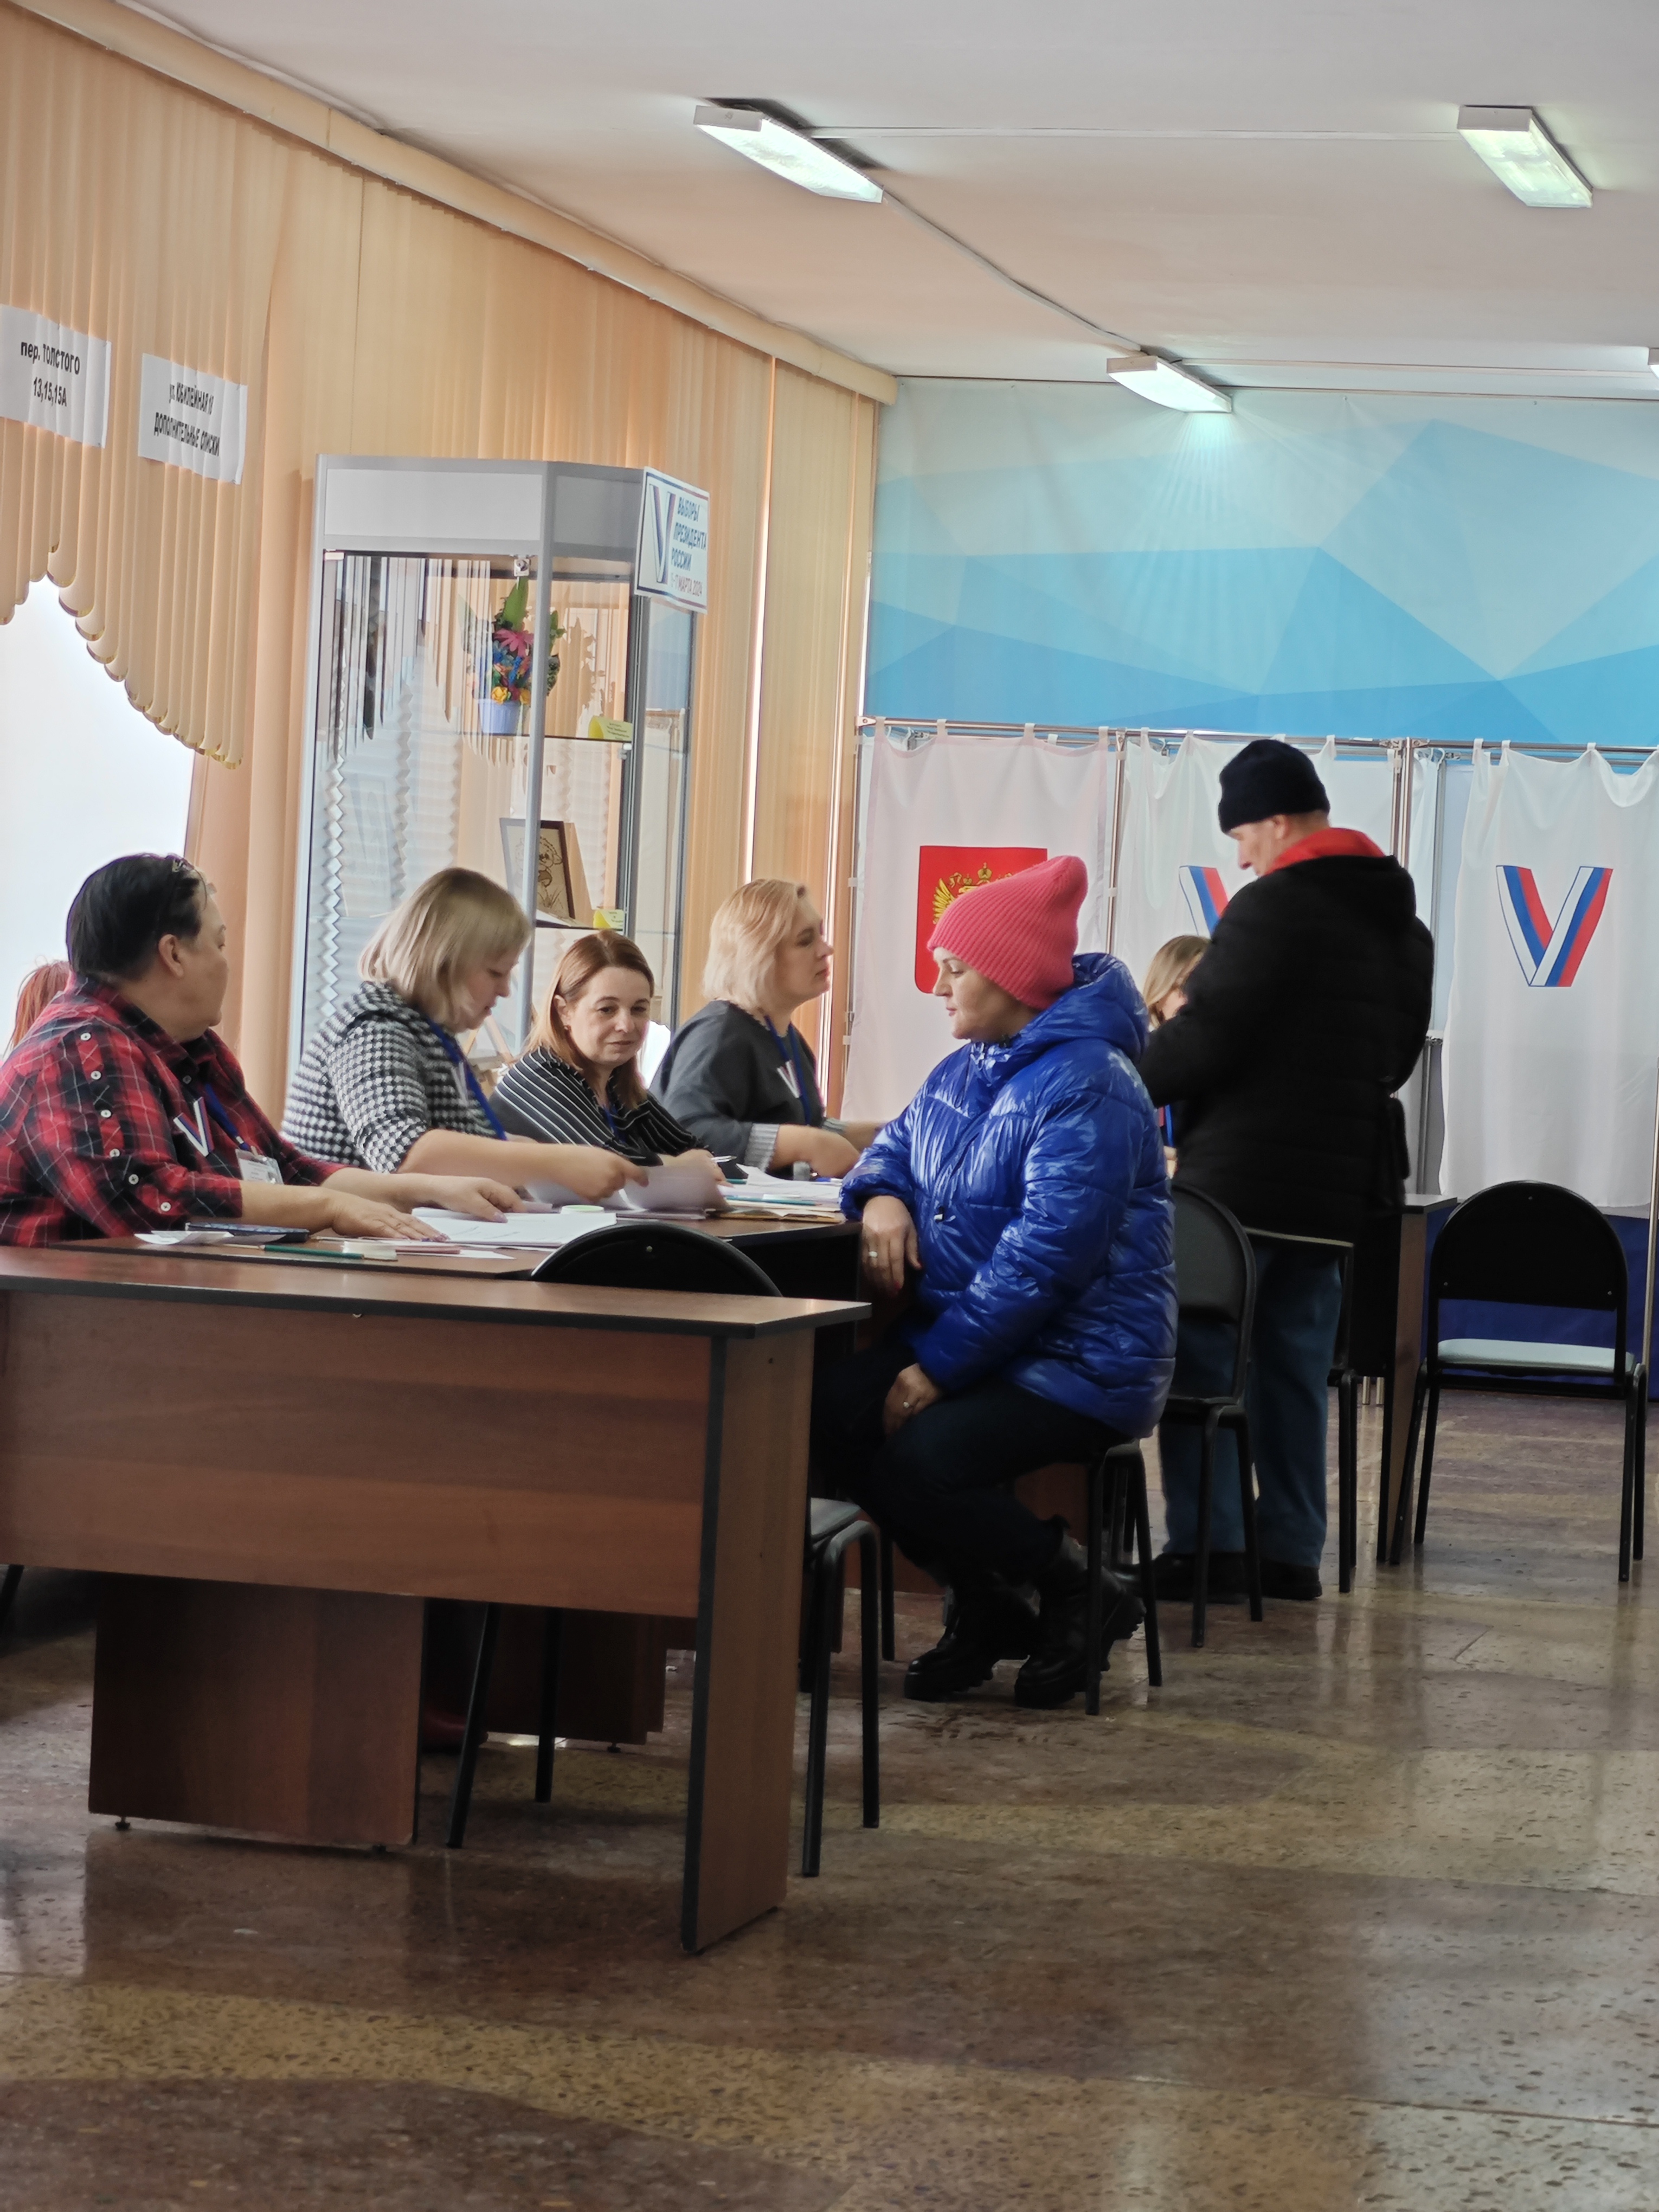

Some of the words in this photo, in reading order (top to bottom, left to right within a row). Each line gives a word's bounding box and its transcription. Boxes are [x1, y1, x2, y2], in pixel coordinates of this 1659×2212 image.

[21, 342, 41, 364] пер.
[43, 344, 80, 375] ТОЛСТОГО
[33, 377, 67, 407] 13,15,15А
[176, 382, 208, 413] ЮБИЛЕЙНАЯ
[153, 412, 200, 448] ДОПОЛНИТЕЛЬНЫЕ
[200, 430, 220, 456] СПИСКИ
[677, 497, 700, 522] ВЫБОРЫ
[673, 522, 707, 550] ПРЕЗИДЕНТА
[671, 547, 692, 571] РОССИИ
